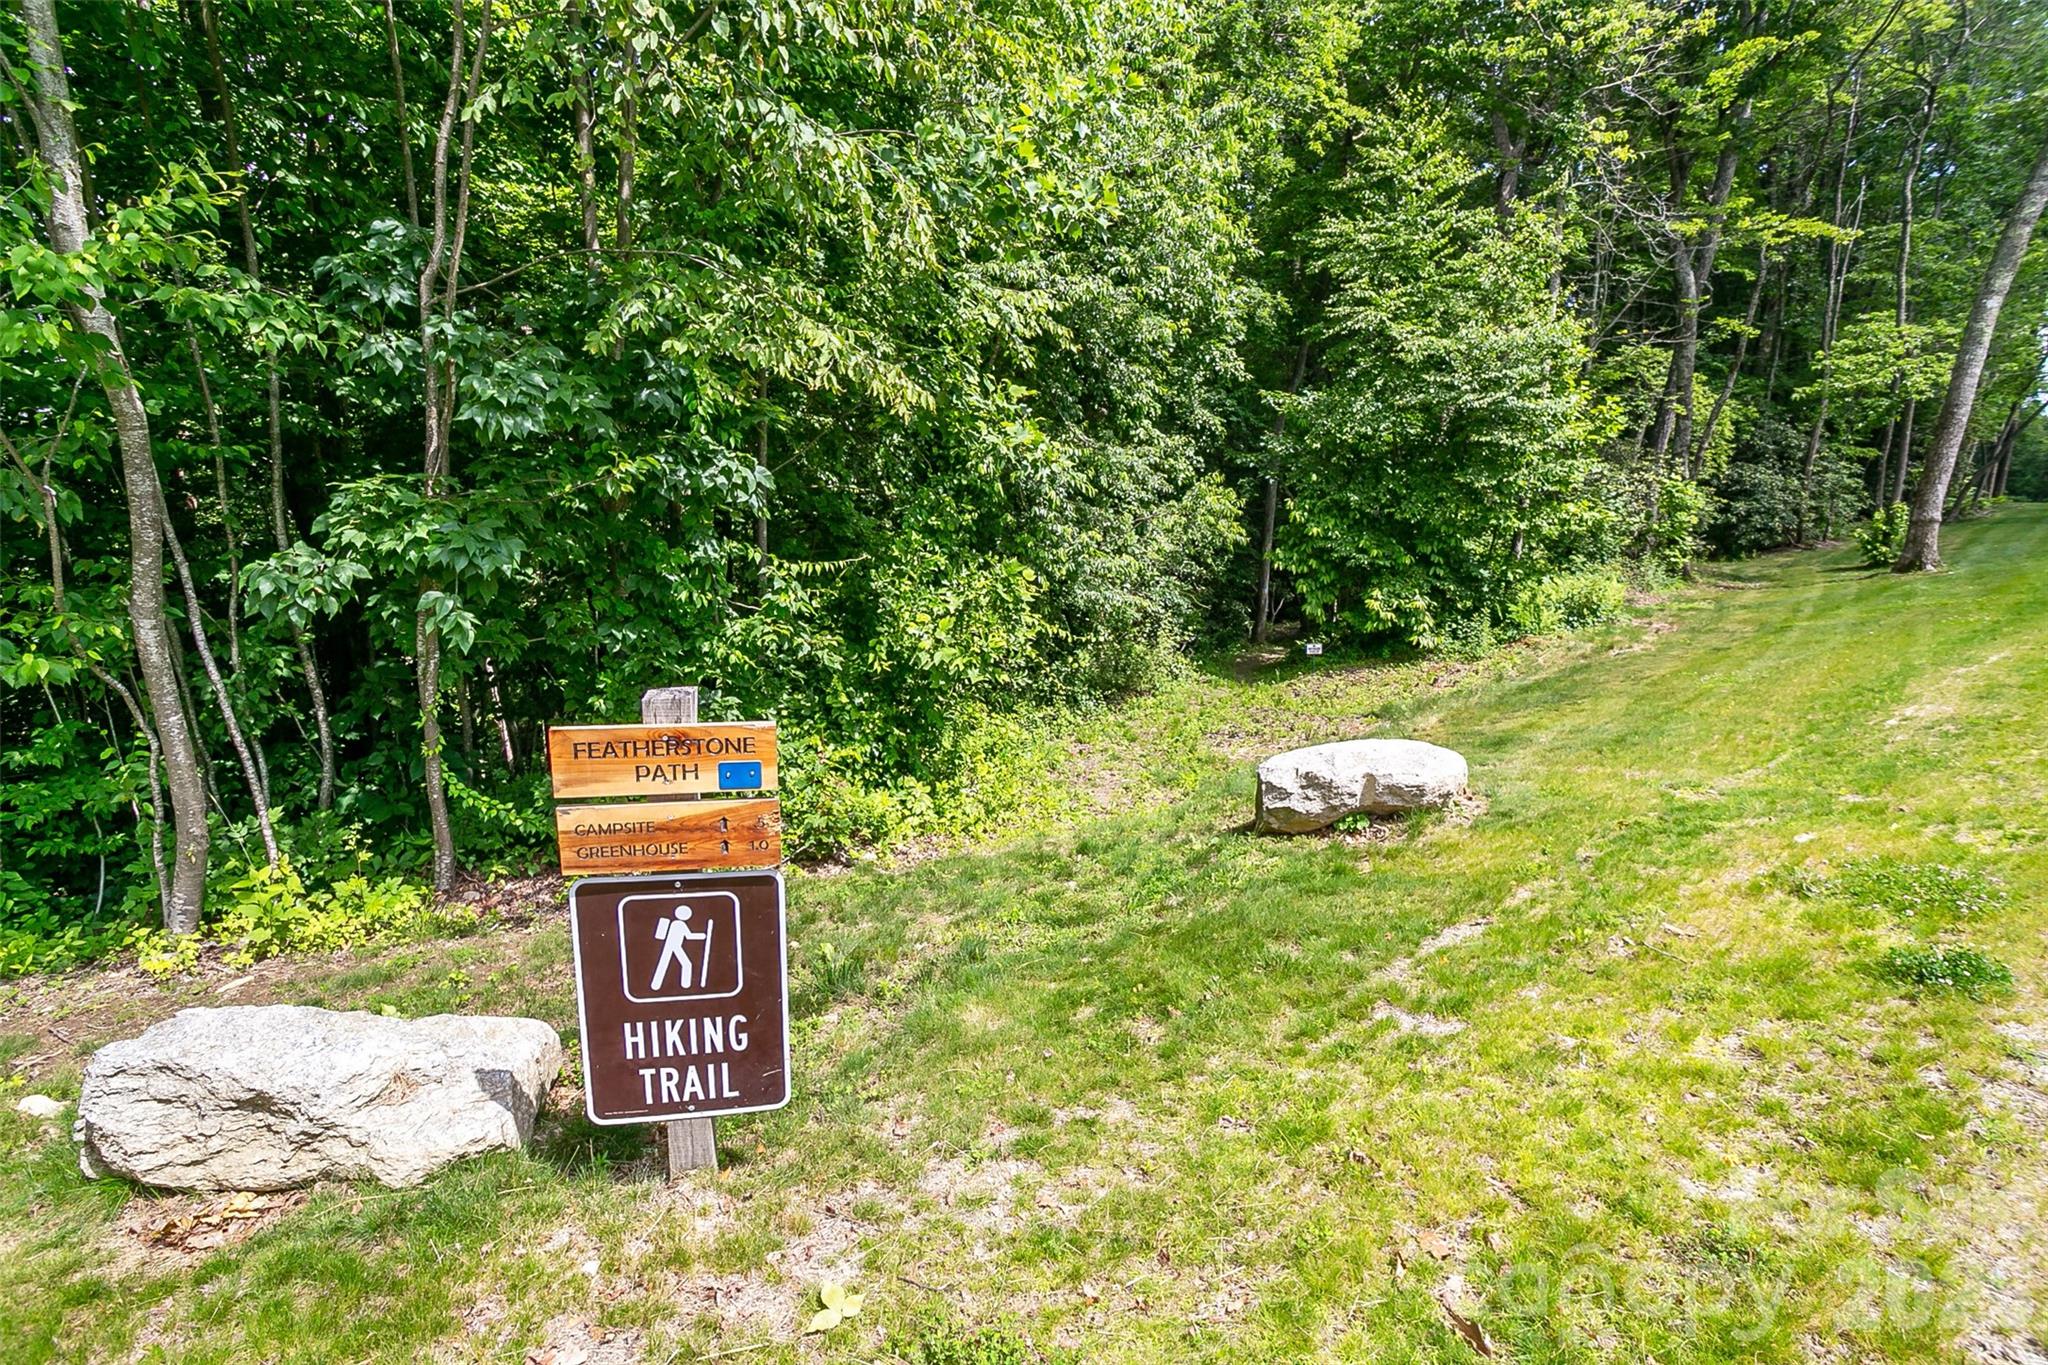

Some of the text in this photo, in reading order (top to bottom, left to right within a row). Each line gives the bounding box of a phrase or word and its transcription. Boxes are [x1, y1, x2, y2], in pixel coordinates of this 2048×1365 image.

[573, 736, 756, 760] FEATHERSTONE
[635, 763, 700, 782] PATH
[574, 821, 656, 837] CAMPSITE
[576, 839, 769, 860] GREENHOUSE 1.0
[623, 1015, 748, 1060] HIKING
[638, 1062, 740, 1104] TRAIL
